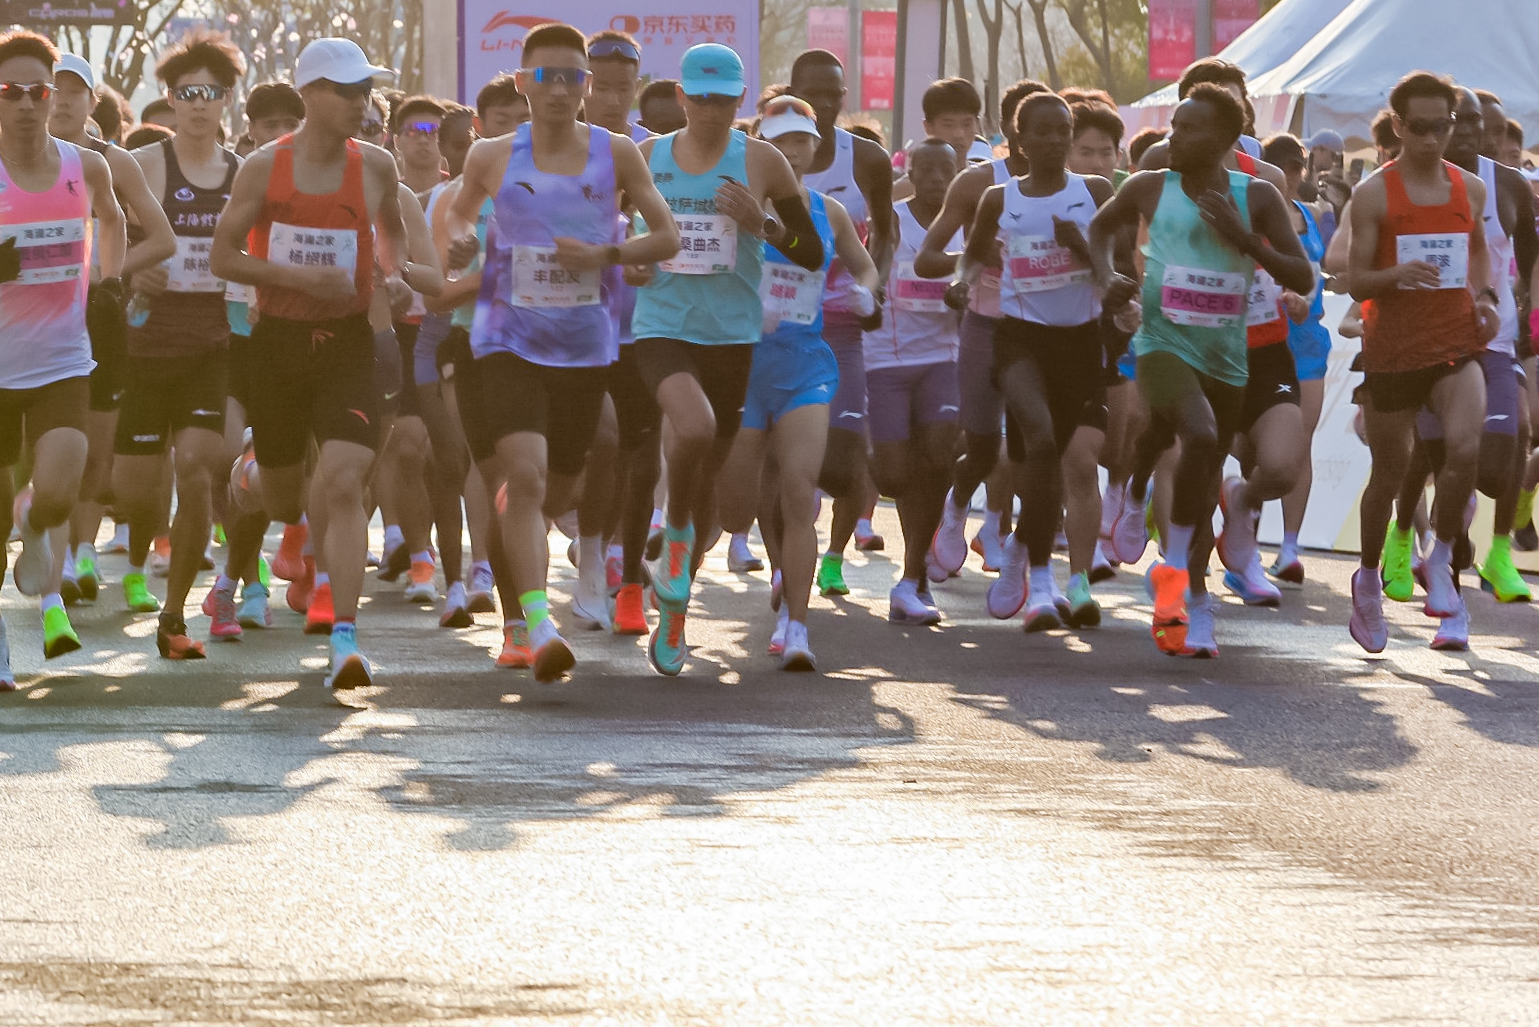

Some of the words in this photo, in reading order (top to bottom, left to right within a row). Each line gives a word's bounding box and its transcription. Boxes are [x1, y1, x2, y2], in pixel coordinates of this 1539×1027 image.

[643, 15, 737, 34] 京东买药
[1029, 252, 1071, 270] ROBE
[1170, 289, 1219, 310] PACE
